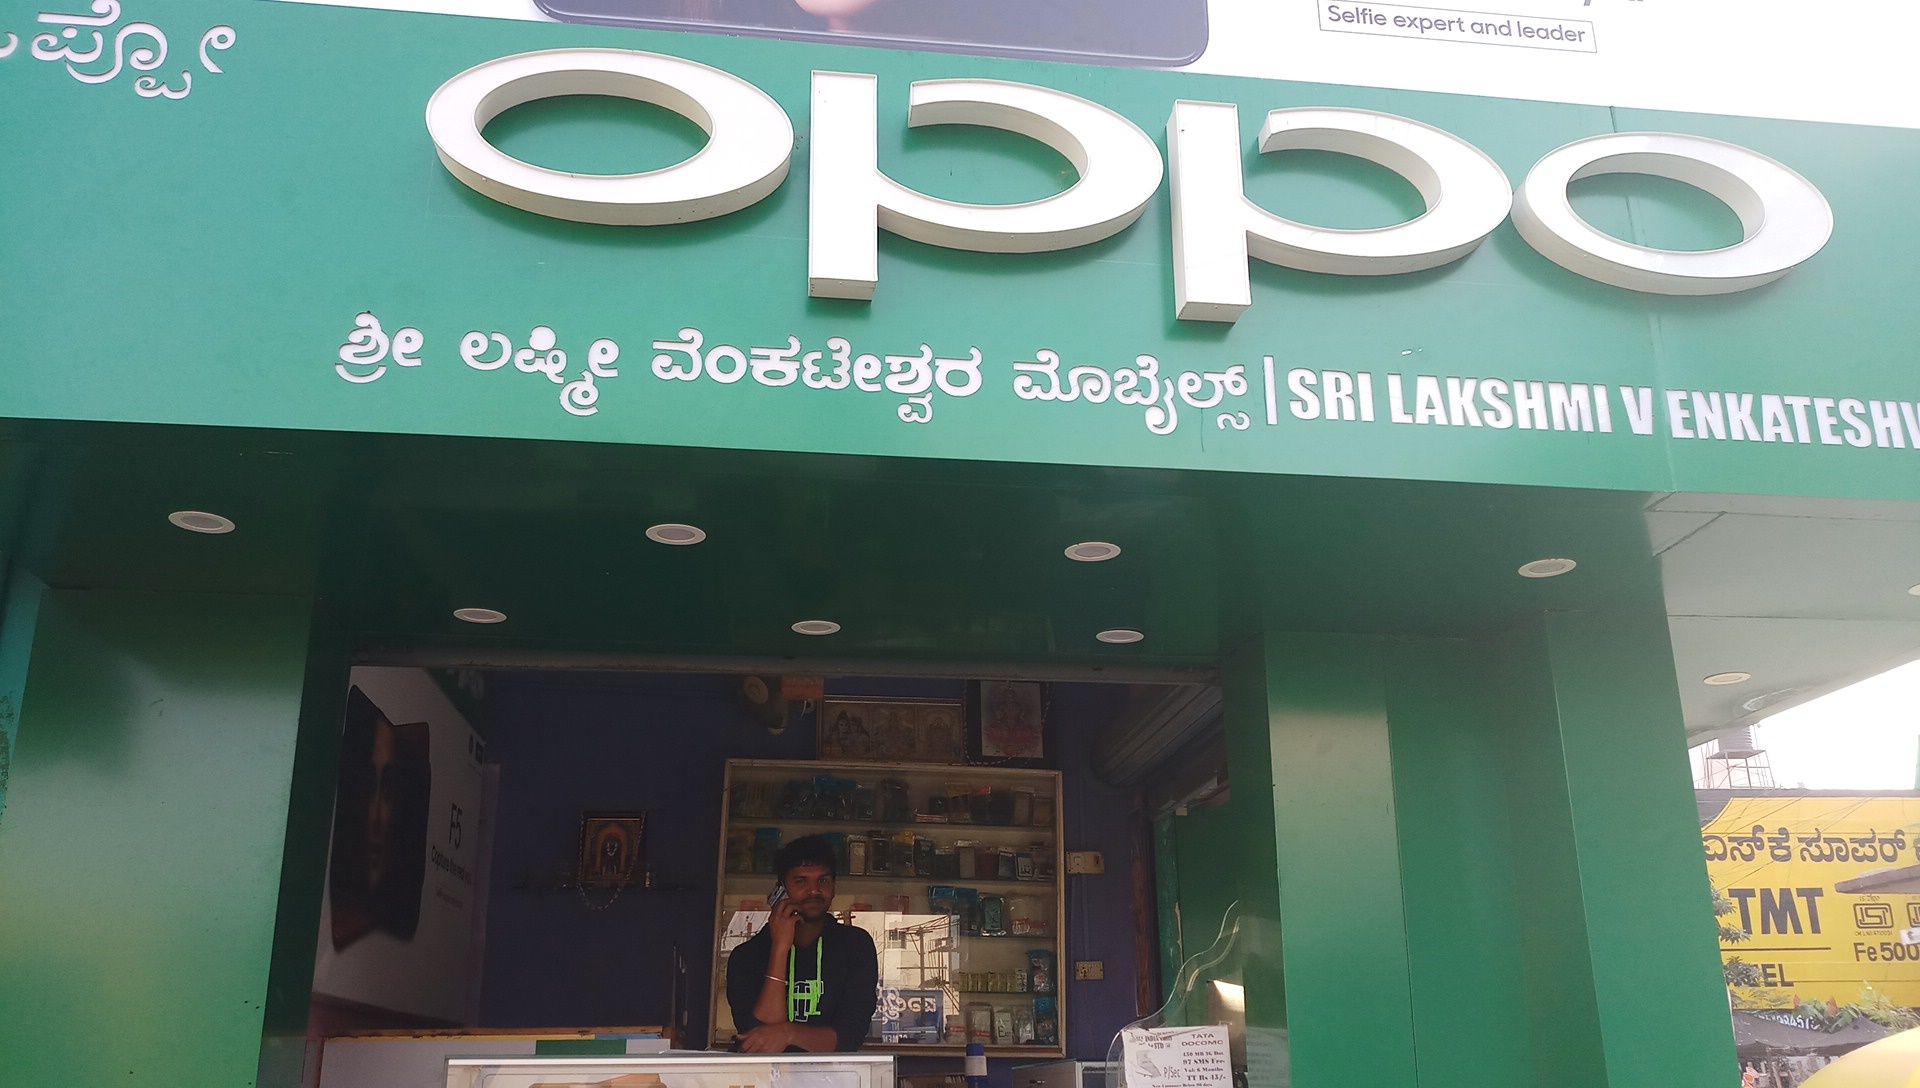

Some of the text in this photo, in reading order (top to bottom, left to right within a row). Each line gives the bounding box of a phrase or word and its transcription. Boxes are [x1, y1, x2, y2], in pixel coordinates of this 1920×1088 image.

[1327, 4, 1587, 43] Selfie expert and leader
[334, 311, 424, 384] ಶ್ರೀ
[1287, 367, 1375, 423] SRI
[1387, 372, 1613, 433] LAKSHMI
[448, 802, 463, 850] F5
[1728, 887, 1824, 935] TMT
[1853, 942, 1878, 962] Fe
